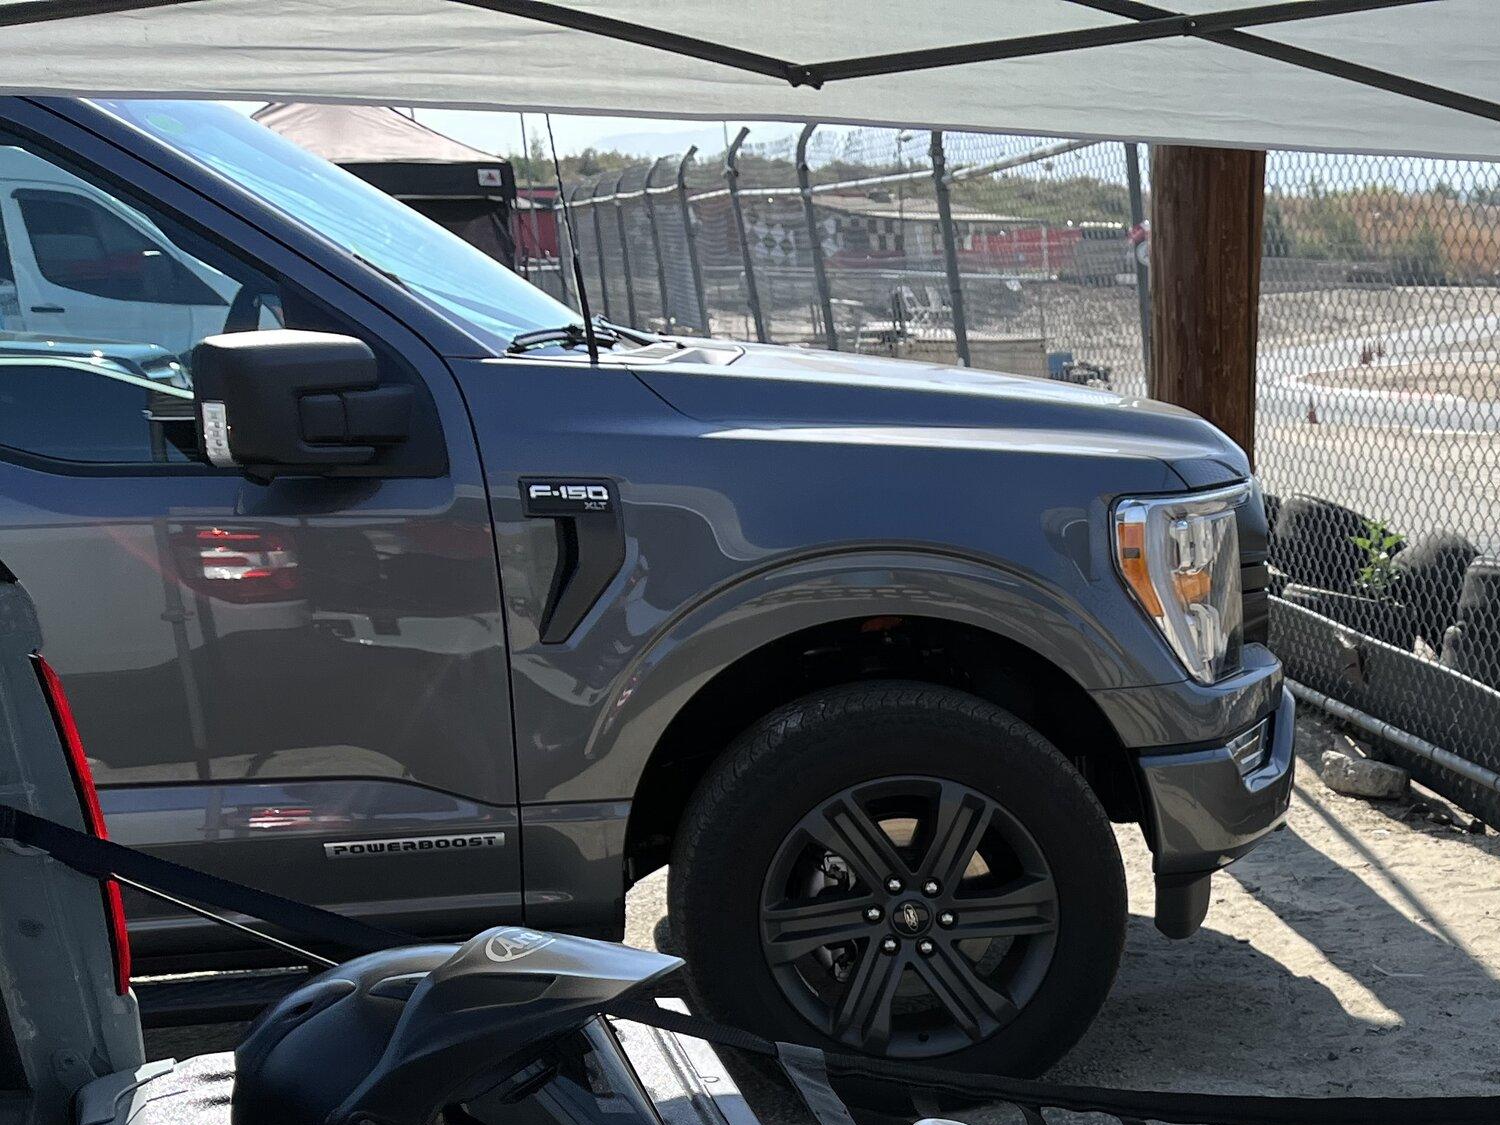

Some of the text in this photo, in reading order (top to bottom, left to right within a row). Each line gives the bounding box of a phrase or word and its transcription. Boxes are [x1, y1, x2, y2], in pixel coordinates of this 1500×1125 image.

[529, 484, 609, 500] F-150
[584, 501, 607, 511] XLT
[333, 836, 496, 856] POWERBOOST
